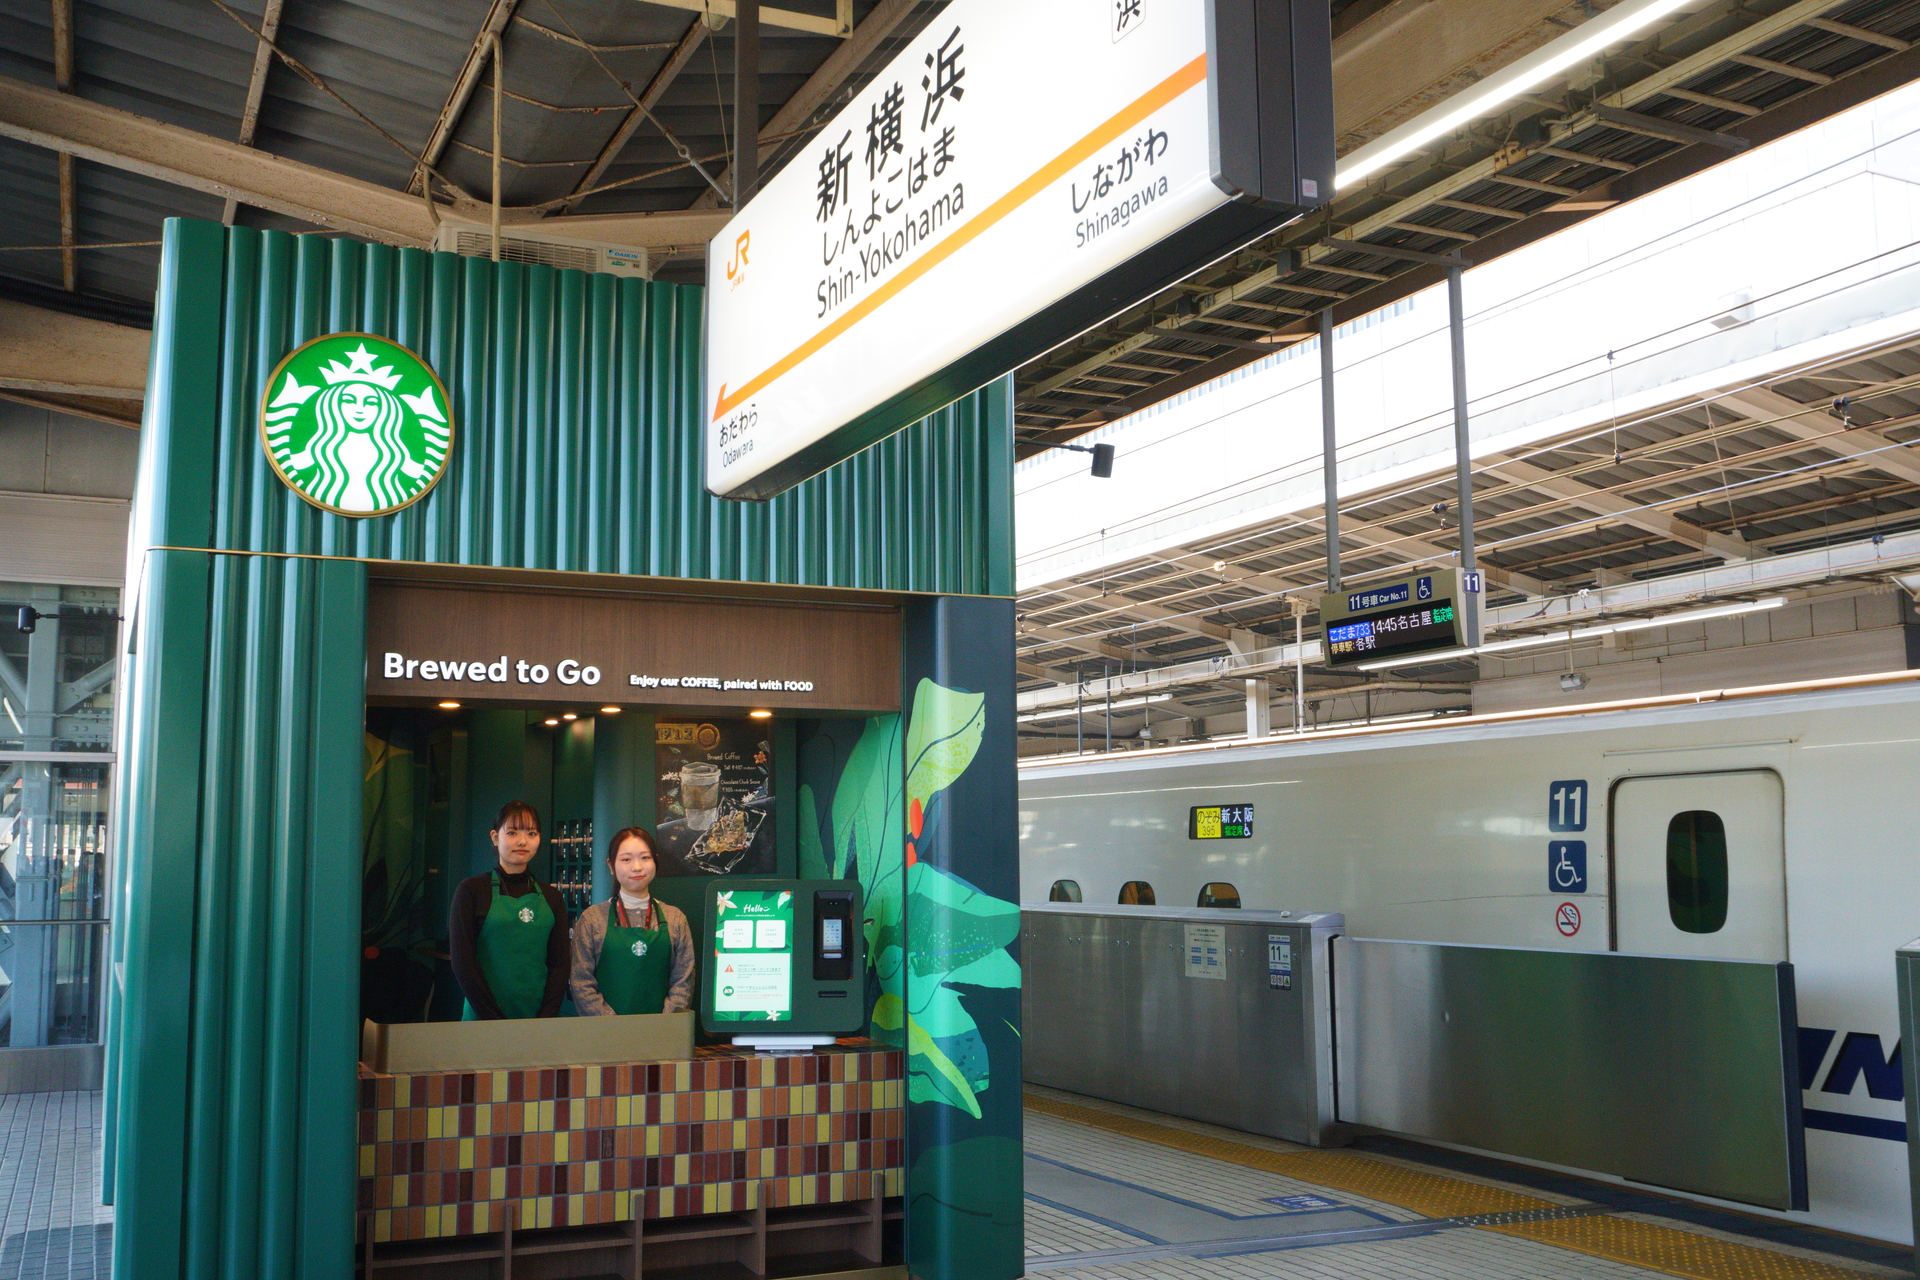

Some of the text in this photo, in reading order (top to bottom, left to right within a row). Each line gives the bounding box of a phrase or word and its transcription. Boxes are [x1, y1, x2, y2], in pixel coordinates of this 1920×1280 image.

[816, 26, 966, 223] 新横浜
[1069, 127, 1169, 215] しながわ
[822, 127, 957, 266] しんよこはま
[1075, 175, 1169, 249] Shinagawa
[614, 251, 639, 259] DAIKIN
[726, 229, 750, 280] JR
[816, 182, 966, 319] Shin-Yokohama
[719, 403, 758, 448] おだわら
[722, 438, 754, 468] Odawara
[1464, 574, 1480, 592] 11
[1349, 590, 1407, 610] 11号車 Car No.11
[1371, 617, 1397, 635] 14:45
[1397, 610, 1433, 630] 名古屋
[383, 652, 601, 685] Brewed to Go
[629, 674, 813, 692] Enjoy our COFFEE, paired with FOOD
[724, 752, 741, 760] Coffee
[1197, 807, 1254, 824] のぞみ 新大阪
[1553, 786, 1582, 826] 11
[1202, 826, 1216, 836] 395
[743, 904, 763, 913] Hello
[1271, 945, 1281, 961] 11
